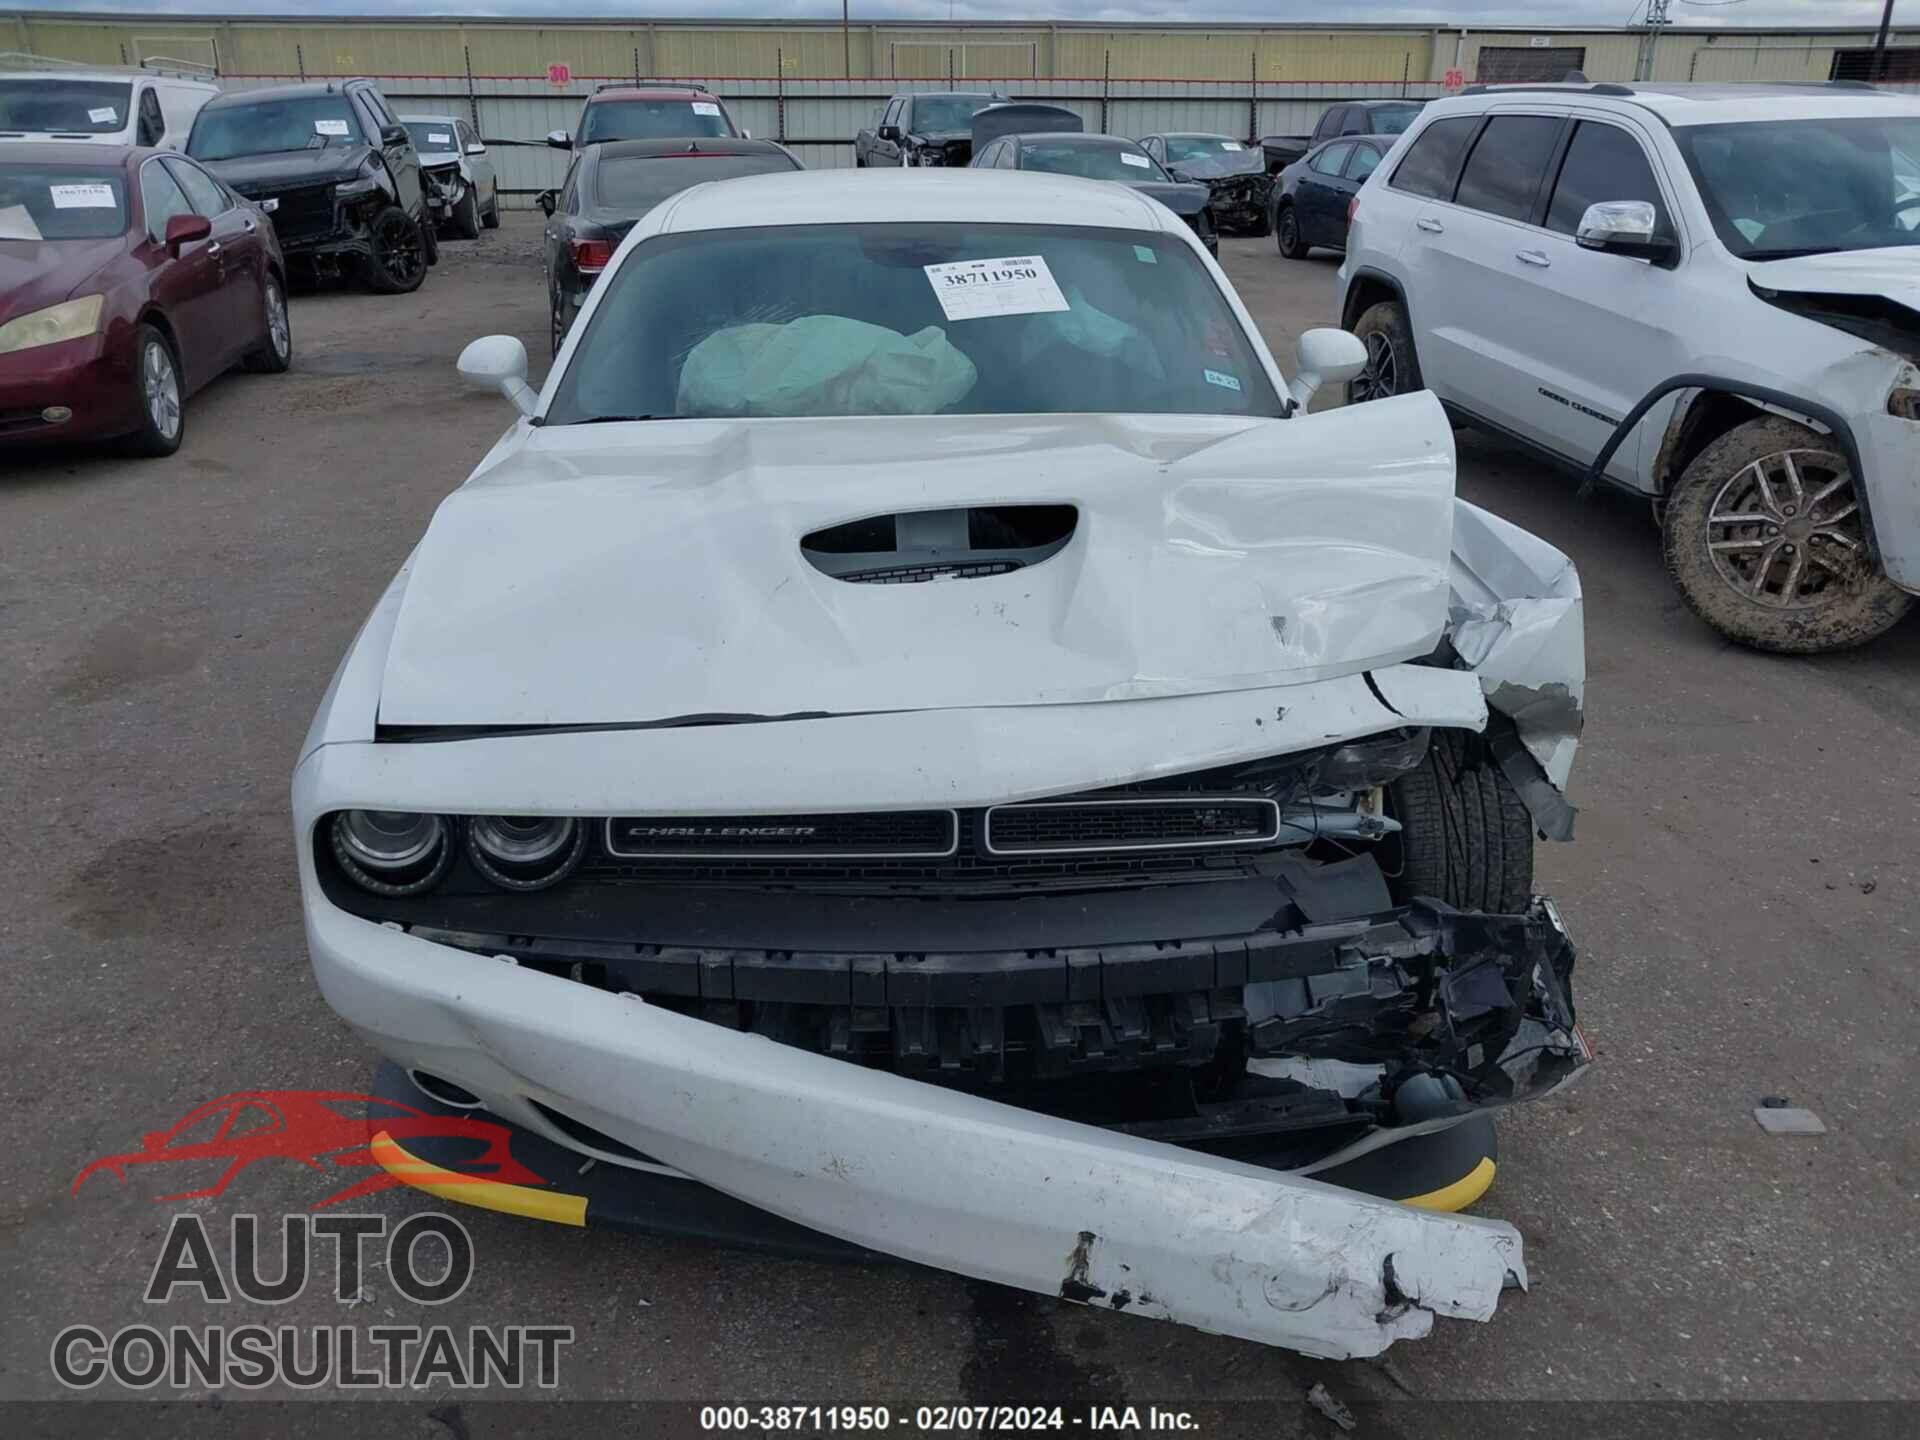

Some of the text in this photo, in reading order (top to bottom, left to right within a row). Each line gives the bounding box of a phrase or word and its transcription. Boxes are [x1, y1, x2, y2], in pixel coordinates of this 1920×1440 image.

[549, 66, 569, 81] 30
[1445, 71, 1463, 87] 35
[943, 268, 1037, 287] 38711950
[629, 826, 815, 837] CHALLENGER
